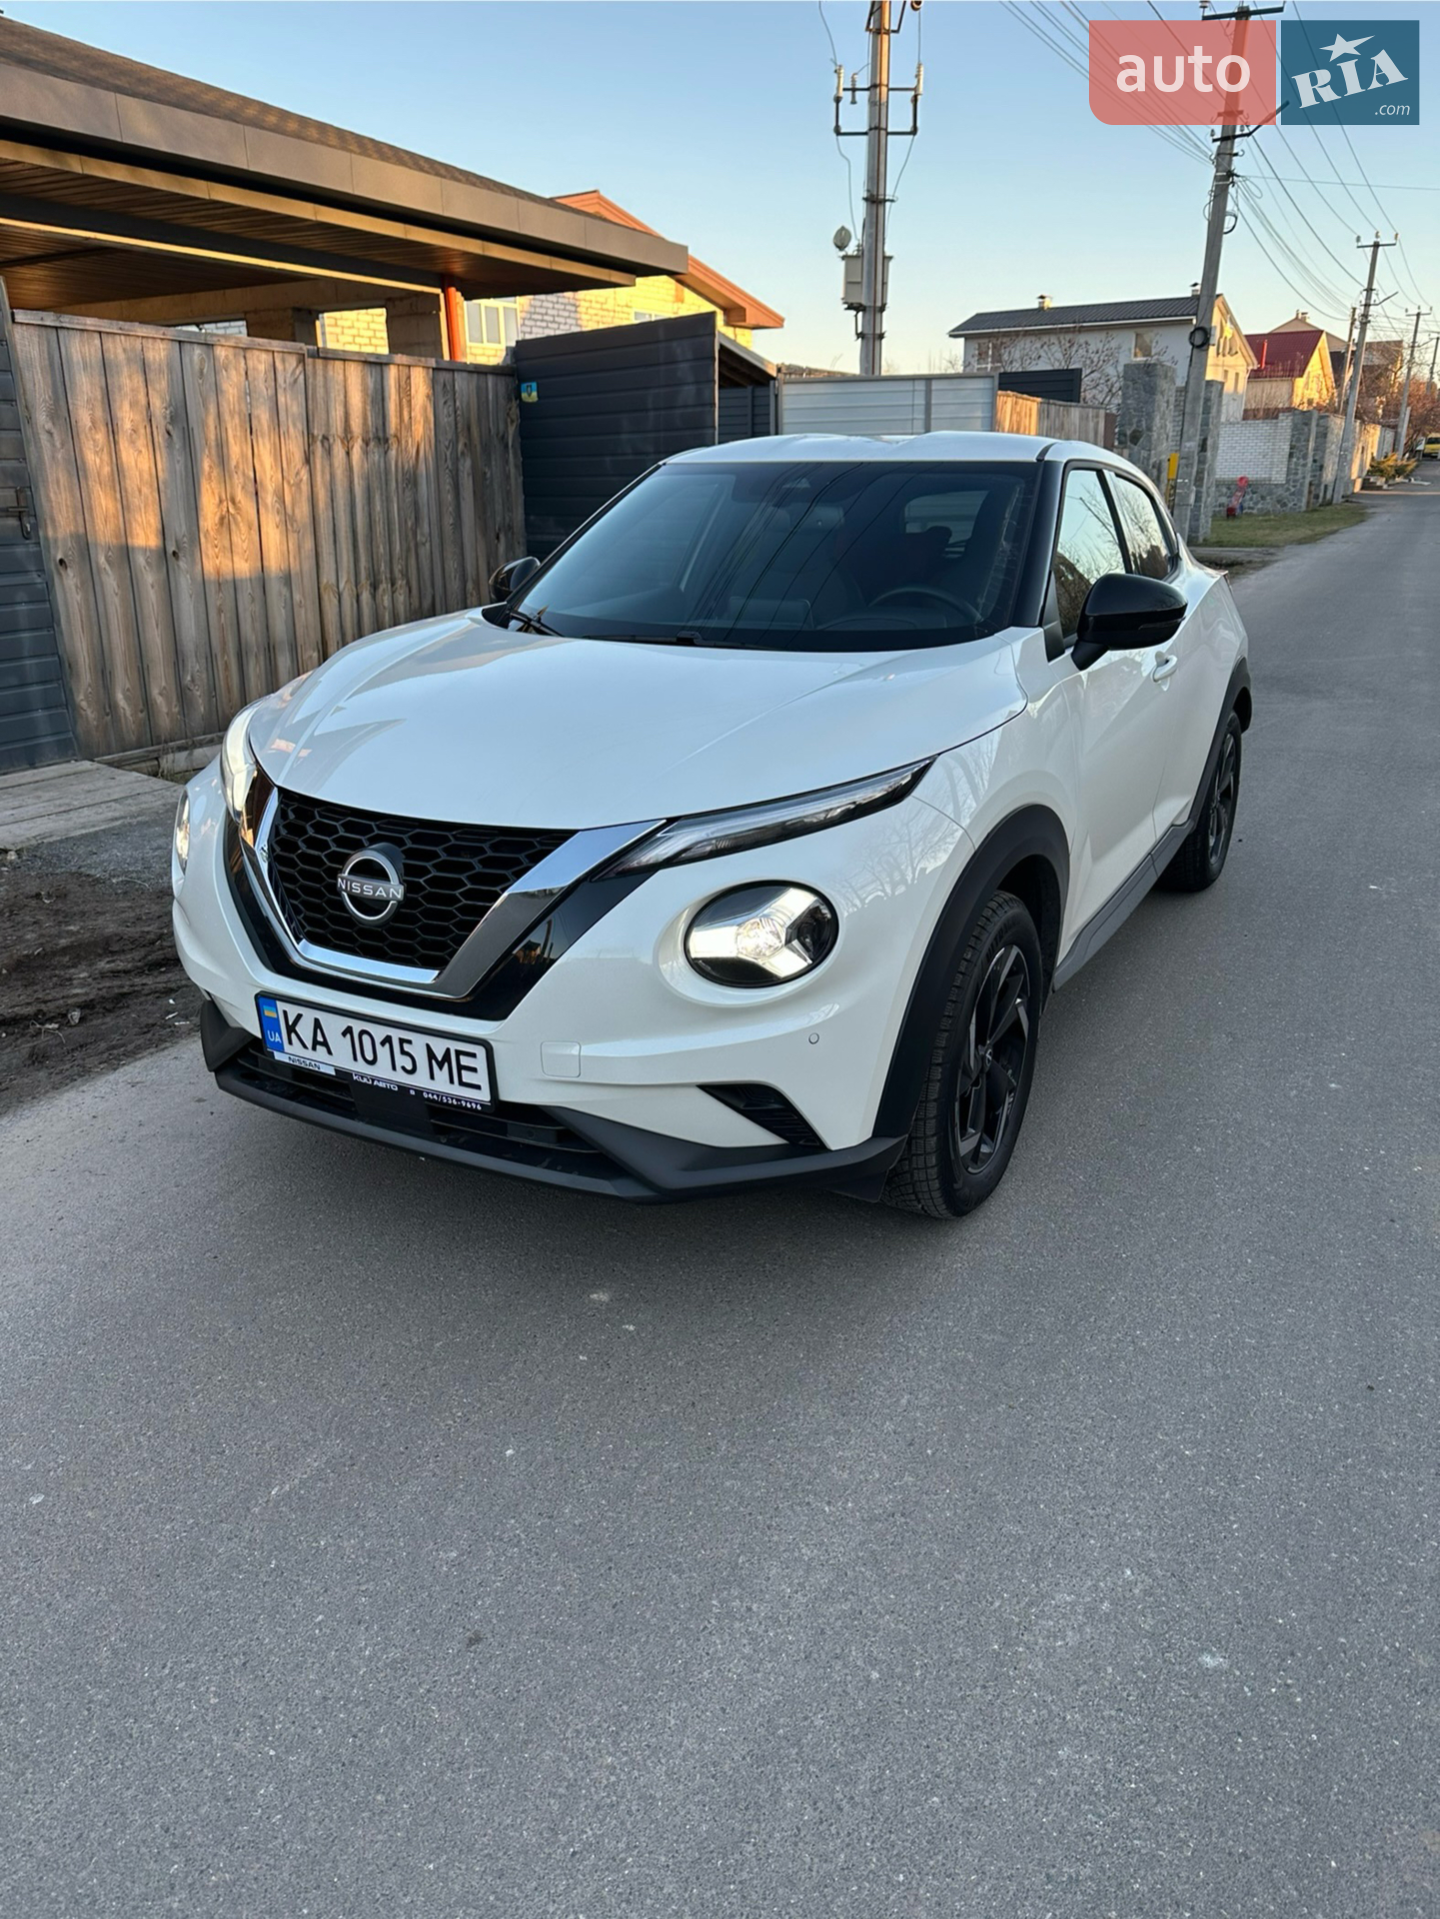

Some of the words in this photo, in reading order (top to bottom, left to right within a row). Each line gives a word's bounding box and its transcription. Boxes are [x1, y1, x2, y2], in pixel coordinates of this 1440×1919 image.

[337, 877, 402, 899] NISSAN
[267, 1030, 282, 1043] UA
[282, 1009, 333, 1057] KA
[341, 1026, 417, 1075] 1015
[426, 1043, 482, 1091] ME
[288, 1056, 321, 1070] NISSAN
